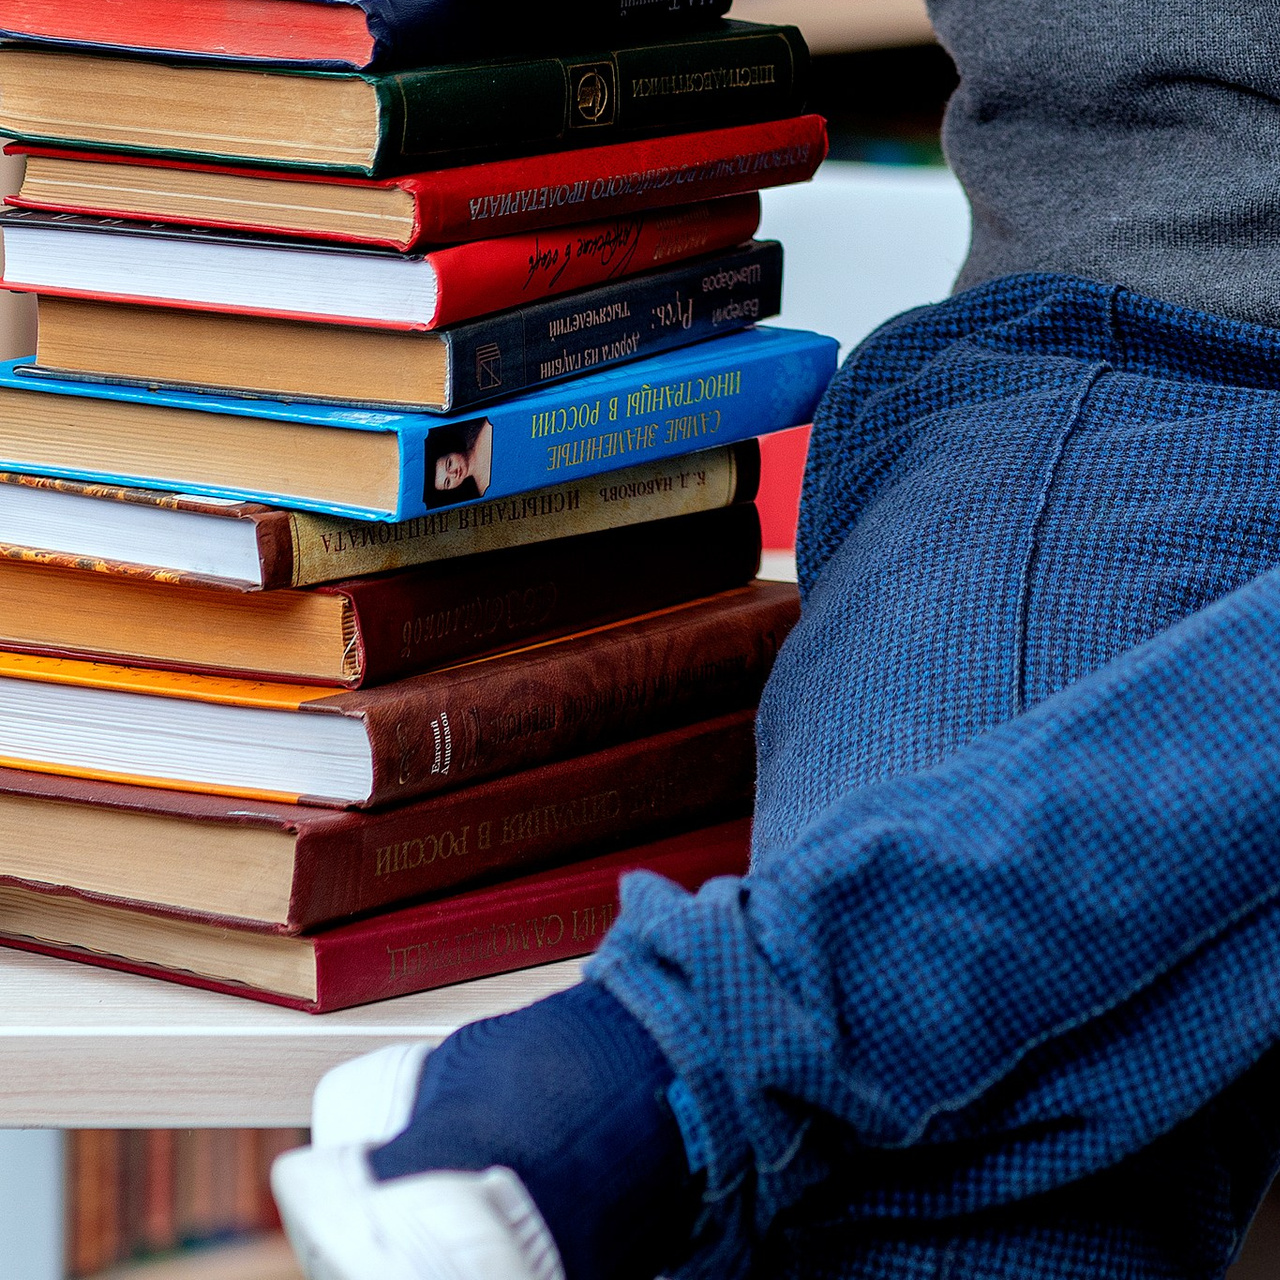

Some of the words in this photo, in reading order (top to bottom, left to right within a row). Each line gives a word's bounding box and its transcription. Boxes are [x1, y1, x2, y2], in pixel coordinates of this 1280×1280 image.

[631, 64, 775, 97] ШЕСТИДЕСЯТНИКИ
[468, 180, 589, 221] ПРОЛЕТАРИАТА
[701, 264, 761, 293] Шамбаров
[711, 297, 760, 327] Валерий
[608, 396, 618, 421] В
[627, 370, 742, 416] ИНОСТРАНЦЫ
[530, 400, 601, 439] РОССИИ
[663, 409, 722, 444] САМЫЕ
[546, 423, 659, 471] ЗНАМЕНИТЫЕ
[599, 476, 673, 503] НАБОКОВЪ
[319, 510, 451, 554] ДИПЛОМАТА
[430, 718, 442, 774] Евгений
[440, 711, 452, 776] Анисимов
[478, 821, 491, 849] В
[500, 790, 621, 845] СИТУАЦИЯ
[375, 824, 470, 880] РОССИИ
